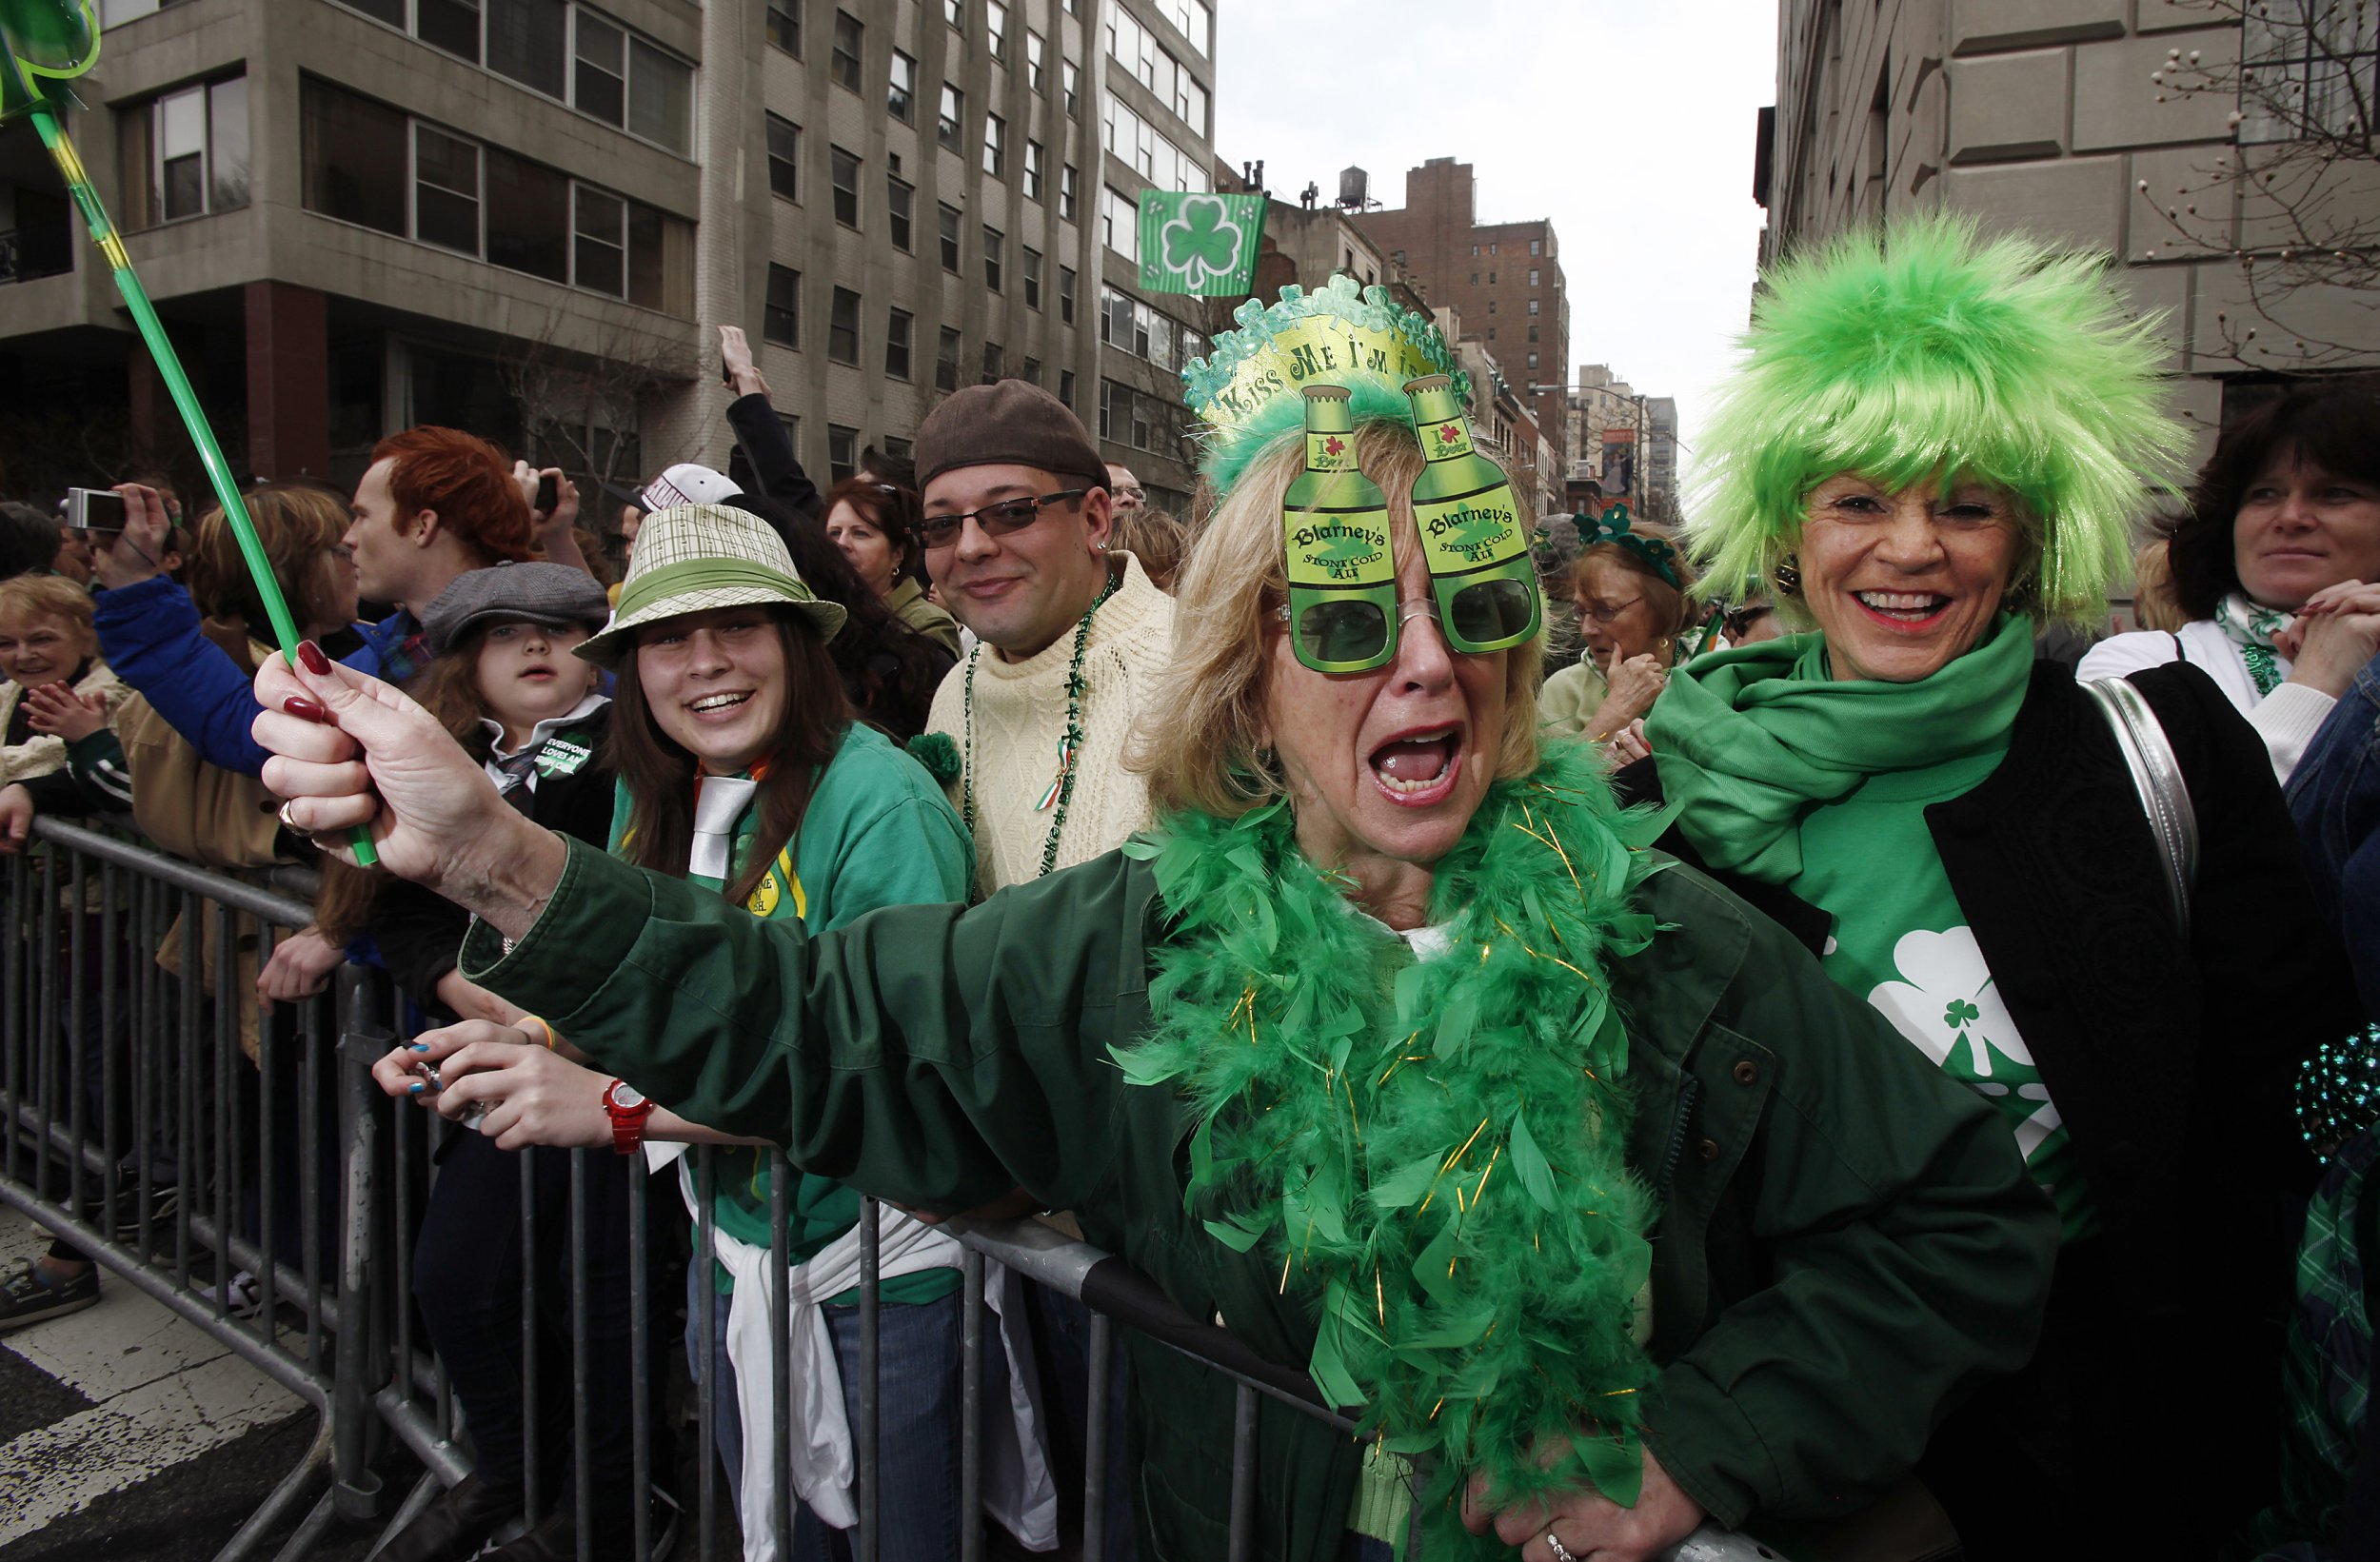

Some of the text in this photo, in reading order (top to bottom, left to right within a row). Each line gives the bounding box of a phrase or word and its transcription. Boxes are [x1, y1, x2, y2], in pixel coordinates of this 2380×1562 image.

[1430, 429, 1444, 445] I
[1316, 440, 1327, 455] I
[1433, 442, 1467, 458] Beer
[1425, 504, 1513, 539] Blarney's
[1292, 524, 1385, 549] Blarney's
[1483, 528, 1513, 547] COLD
[1350, 552, 1383, 566] COLD
[541, 746, 568, 760] LOVES
[546, 738, 591, 758] EVERYONE
